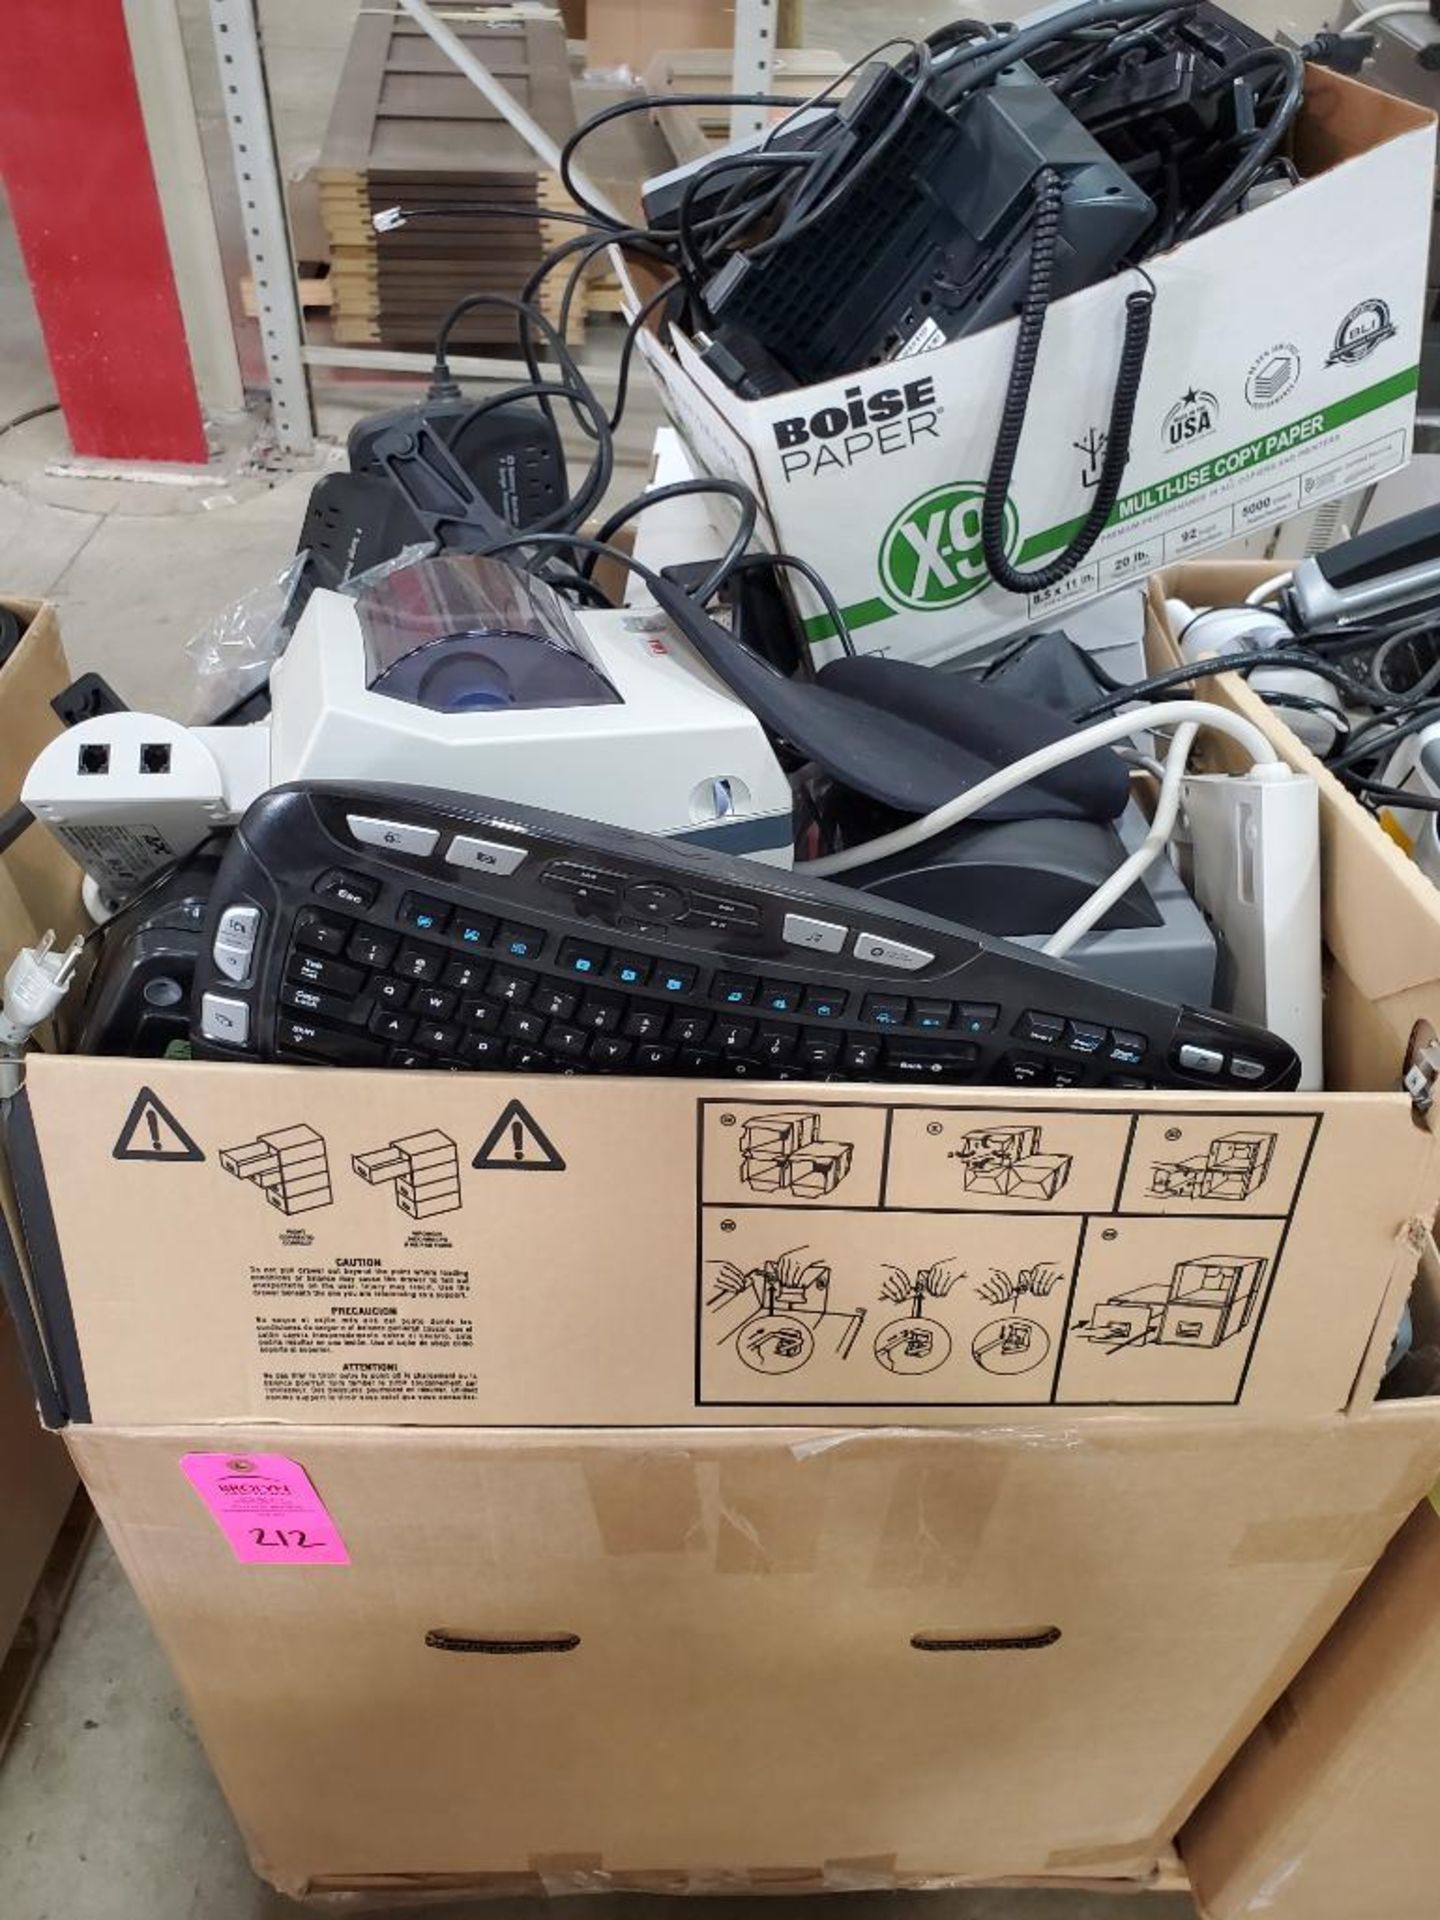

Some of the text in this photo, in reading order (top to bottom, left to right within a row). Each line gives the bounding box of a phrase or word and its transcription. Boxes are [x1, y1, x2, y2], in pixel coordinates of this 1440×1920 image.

[1169, 410, 1212, 444] USA
[1118, 463, 1211, 520] MULTI-USE
[1214, 441, 1262, 478] COPY
[1264, 414, 1324, 456] PAPER
[1242, 497, 1271, 518] 5000
[1181, 528, 1198, 541] 92
[1114, 556, 1130, 571] 20
[335, 1258, 382, 1268] CAUTION
[248, 1527, 326, 1549] 212
